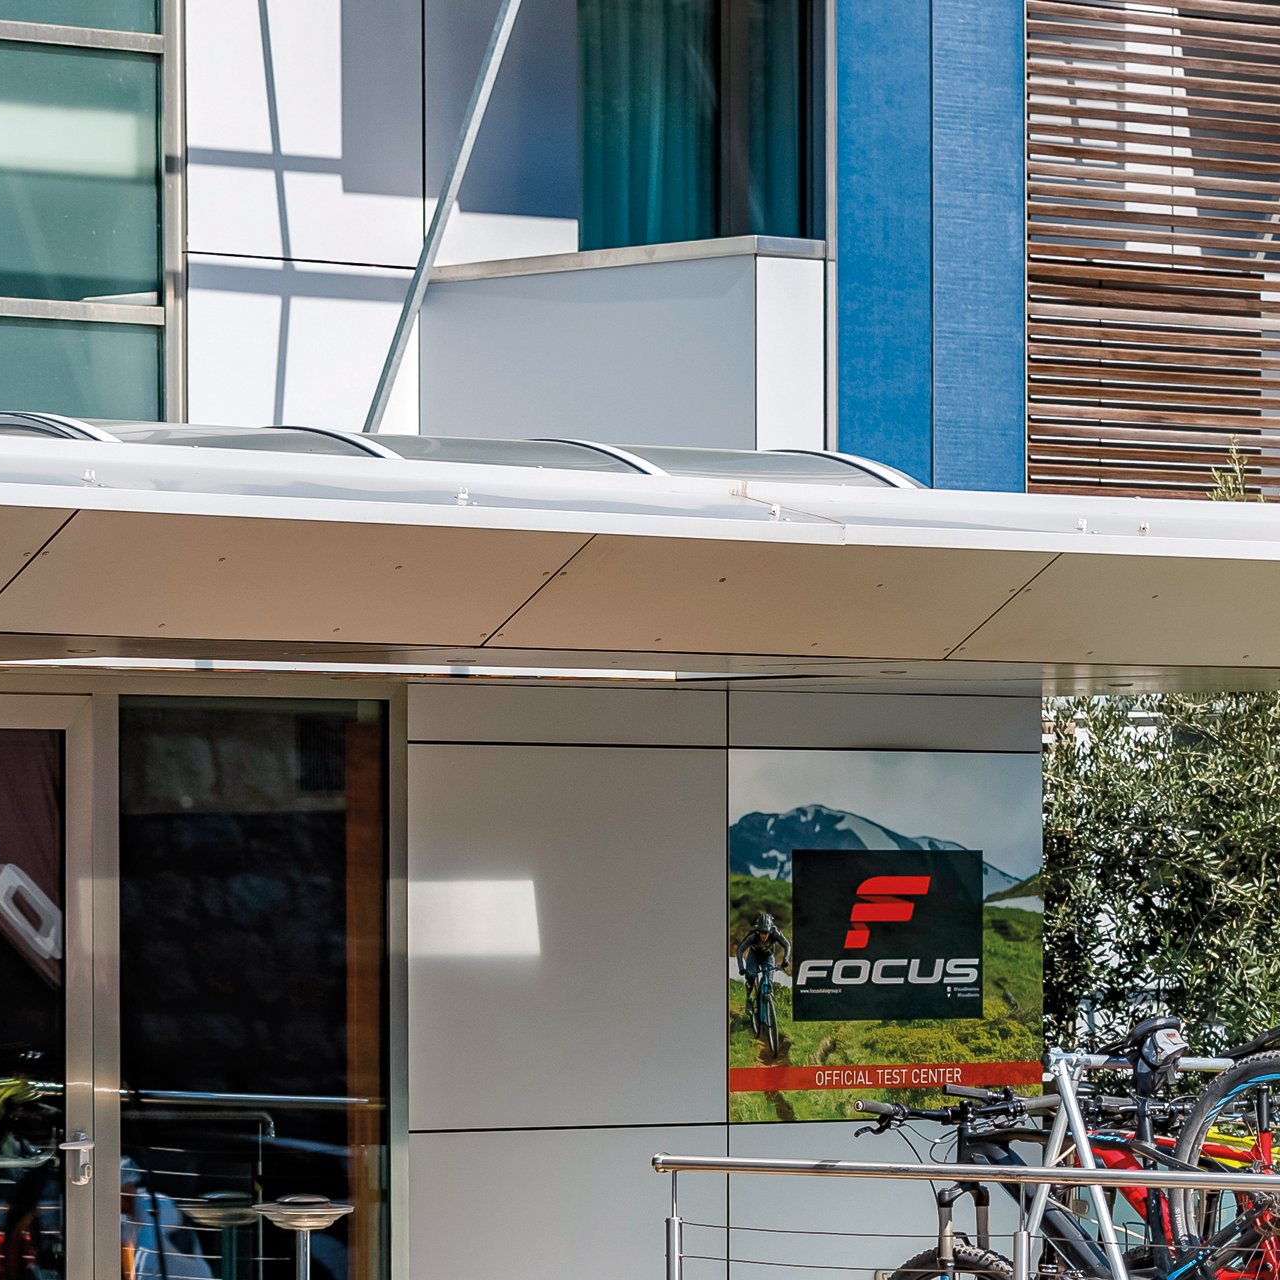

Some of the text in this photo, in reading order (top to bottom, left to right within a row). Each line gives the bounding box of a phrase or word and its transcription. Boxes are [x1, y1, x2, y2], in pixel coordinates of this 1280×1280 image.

[796, 958, 980, 985] FOCUS
[815, 1068, 962, 1086] OFFICIAL TEST CENTER
